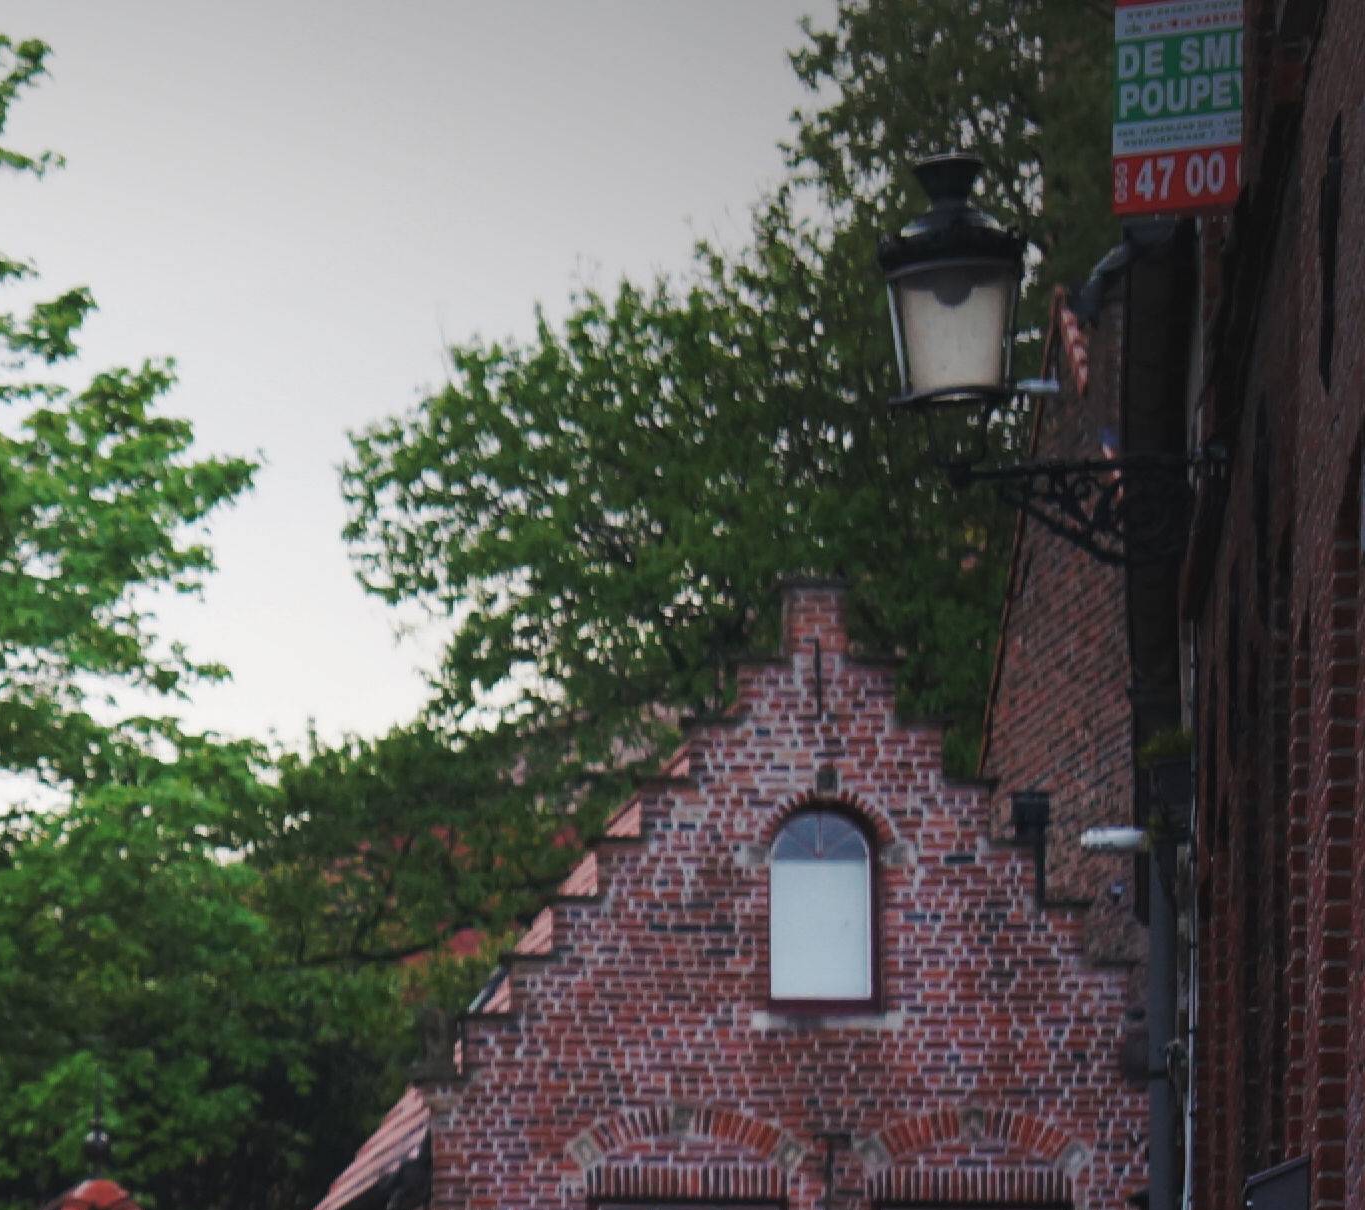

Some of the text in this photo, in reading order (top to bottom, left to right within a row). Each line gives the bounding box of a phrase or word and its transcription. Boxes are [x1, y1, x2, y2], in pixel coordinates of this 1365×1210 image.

[1119, 42, 1163, 78] DE
[1135, 155, 1175, 201] 47
[1186, 151, 1225, 196] 00
